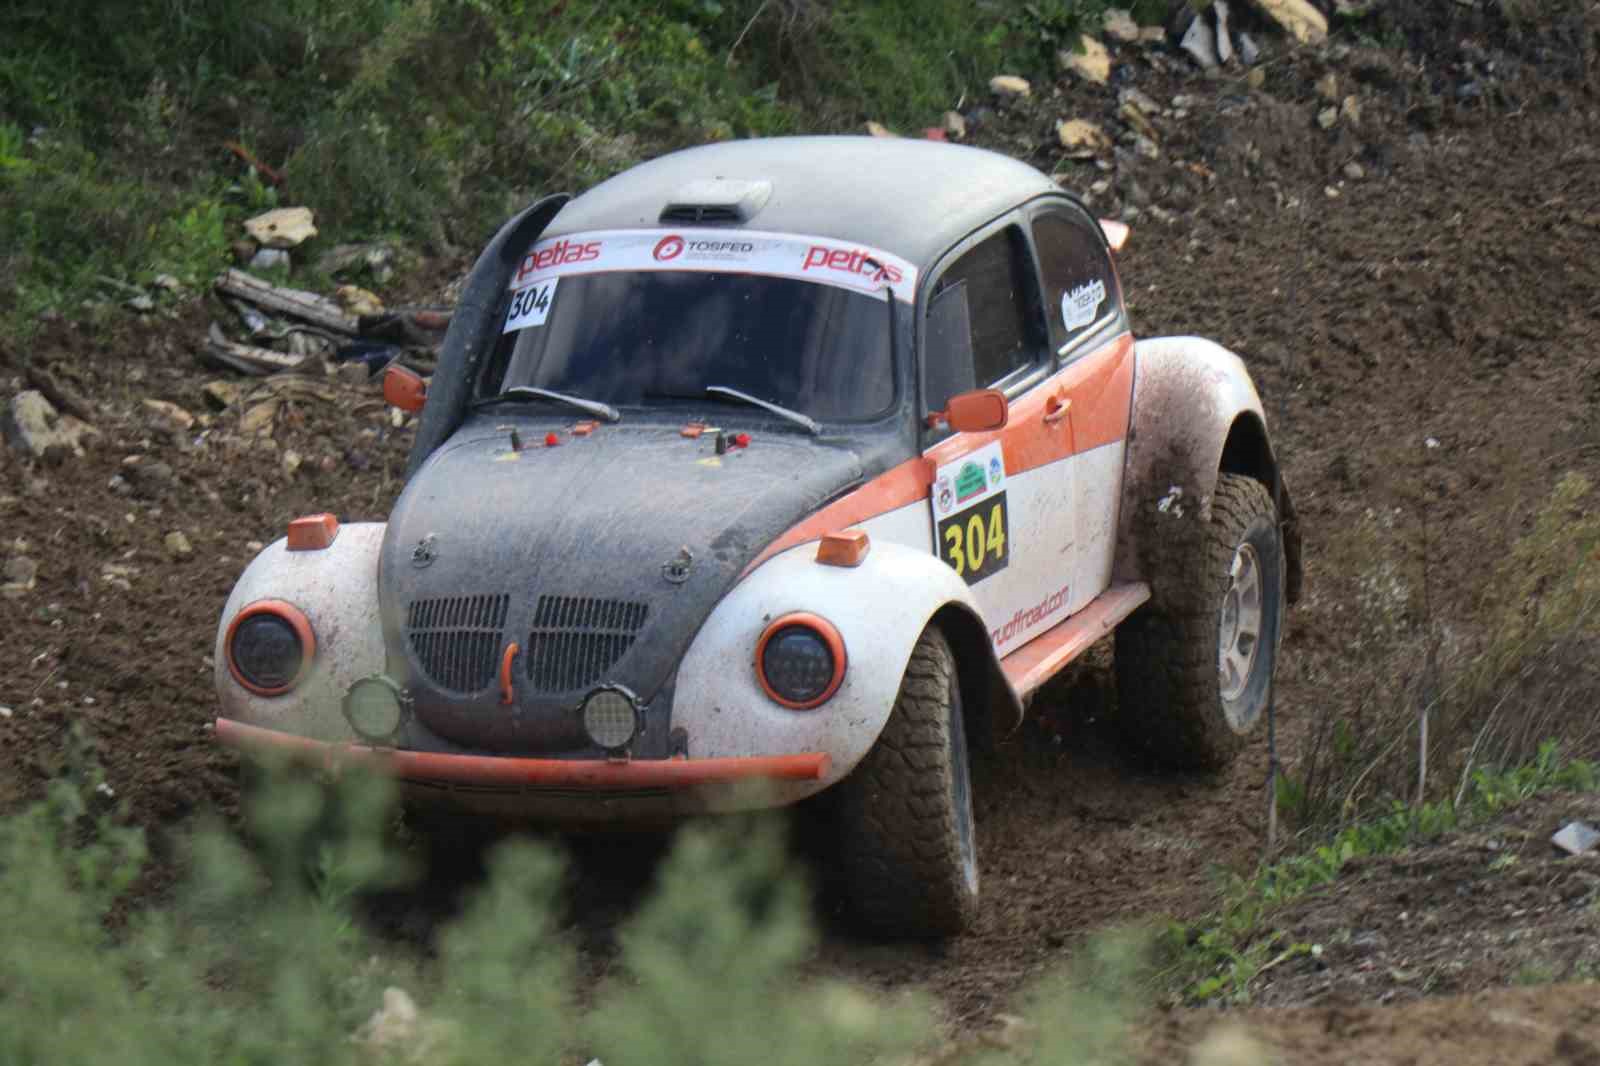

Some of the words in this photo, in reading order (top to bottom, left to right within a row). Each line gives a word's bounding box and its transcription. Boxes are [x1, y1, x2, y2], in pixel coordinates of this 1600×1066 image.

[516, 240, 603, 281] petlas
[688, 241, 753, 253] TOSFED
[509, 285, 549, 320] 304
[945, 503, 1005, 577] 304
